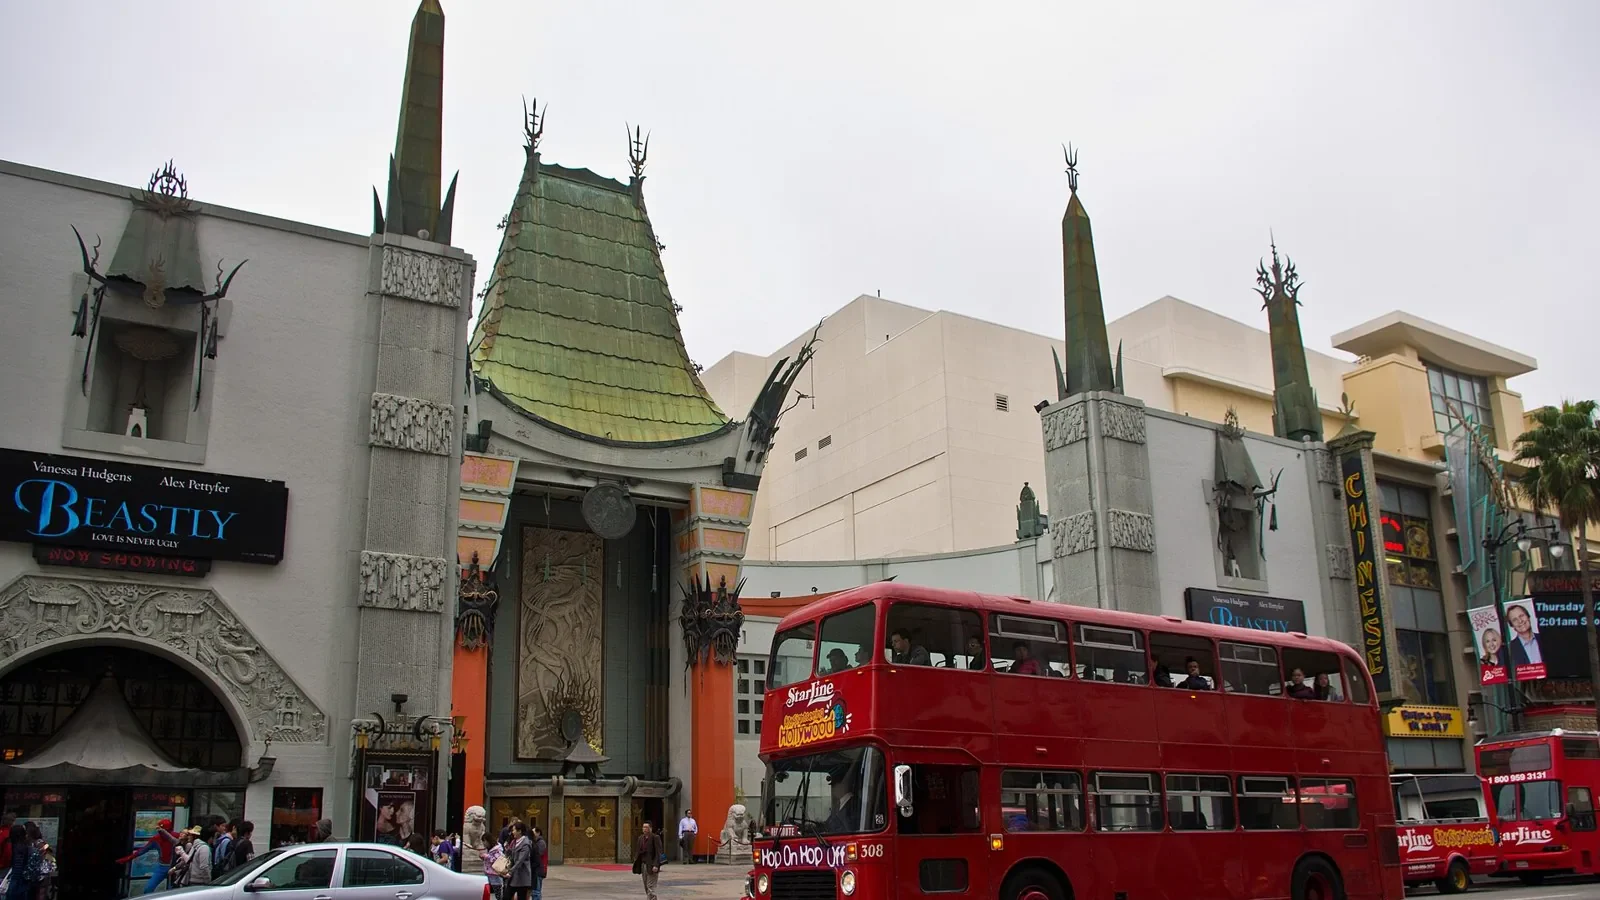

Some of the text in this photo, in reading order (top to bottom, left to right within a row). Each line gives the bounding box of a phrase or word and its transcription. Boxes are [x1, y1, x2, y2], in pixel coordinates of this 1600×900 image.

[33, 461, 132, 483] Vanessa Hudgens
[159, 476, 231, 494] Alex Pettyfer
[15, 479, 240, 540] BEASTLY
[92, 533, 180, 549] LOVE IS NEVER UGLY
[48, 548, 197, 572] NOW SHOWING
[1346, 472, 1384, 676] CHINESE
[1535, 602, 1585, 613] Thursday
[1539, 617, 1578, 627] 2:01am
[786, 680, 835, 708] StarLine
[1494, 775, 1509, 784] 800
[1510, 774, 1526, 782] 959
[1526, 771, 1547, 780] 3131
[761, 845, 846, 869] Hop On Hop Off
[861, 844, 884, 858] 308
